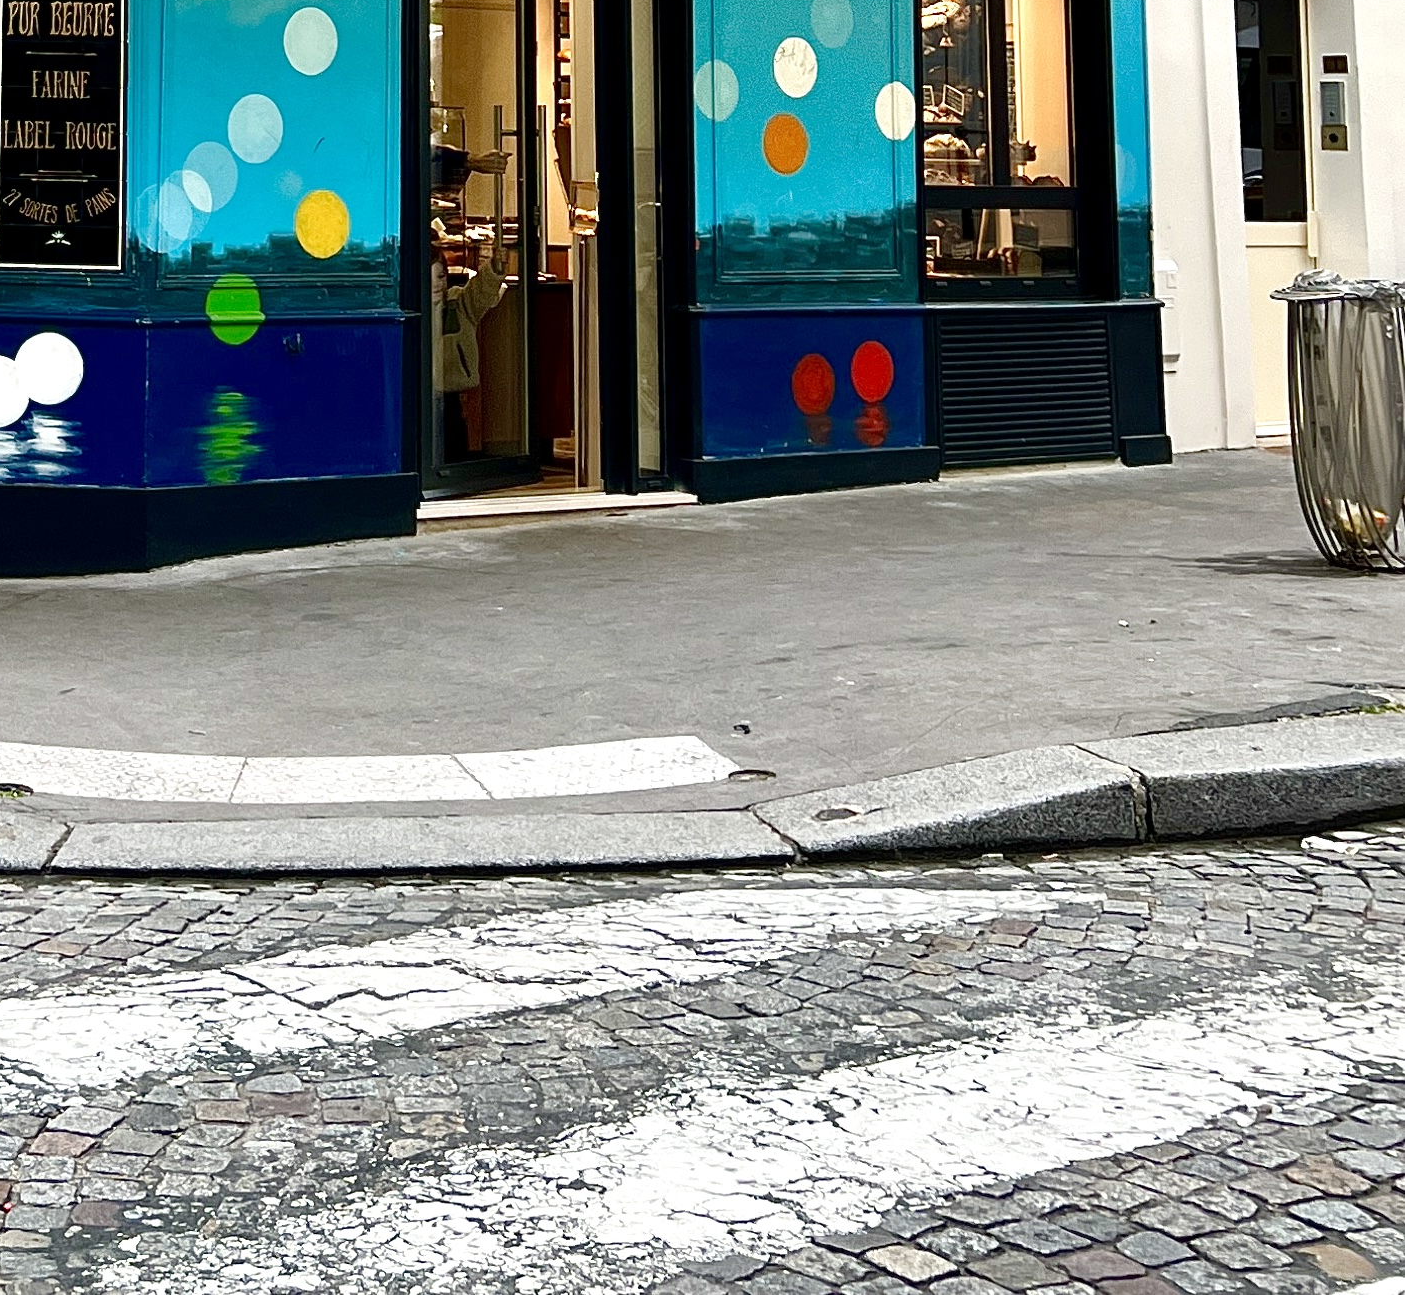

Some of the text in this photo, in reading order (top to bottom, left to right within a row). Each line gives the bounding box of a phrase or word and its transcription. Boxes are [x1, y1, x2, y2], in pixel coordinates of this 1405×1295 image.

[7, 1, 115, 38] PUR BEURRE
[31, 70, 91, 99] FARINE
[3, 120, 117, 150] LABEL ROUGE
[19, 197, 58, 224] SORTES
[65, 203, 80, 223] DE
[85, 188, 116, 217] PAINS
